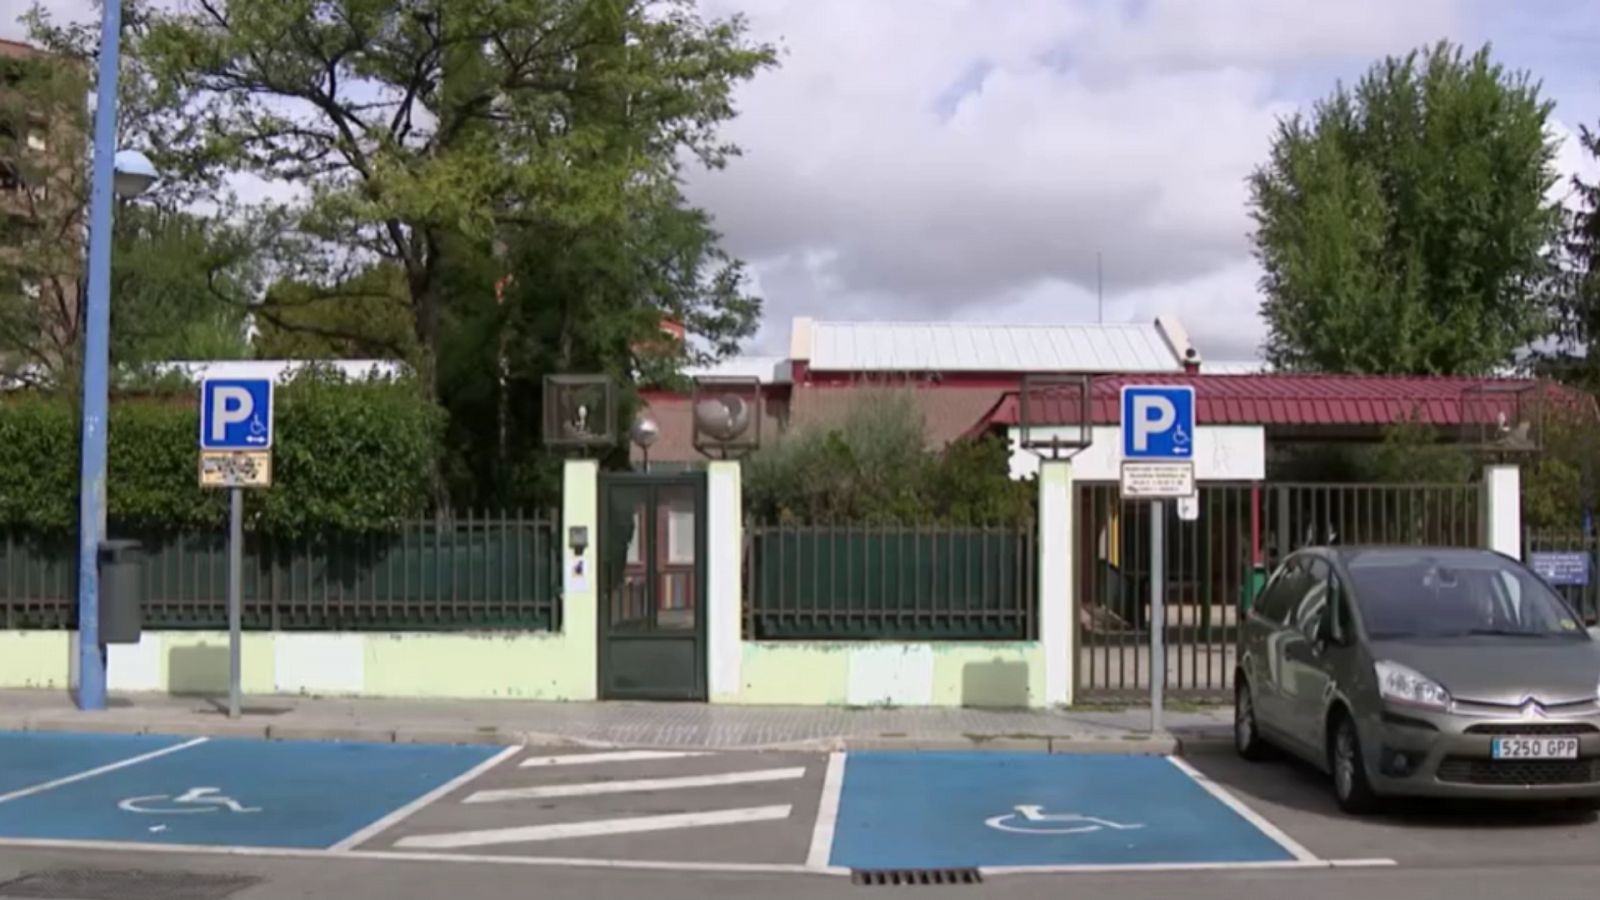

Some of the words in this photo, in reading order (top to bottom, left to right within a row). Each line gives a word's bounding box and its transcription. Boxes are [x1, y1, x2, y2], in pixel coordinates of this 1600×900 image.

[212, 386, 254, 441] P
[1134, 395, 1176, 451] P
[1502, 740, 1541, 756] 5250
[1548, 740, 1576, 756] GPP
